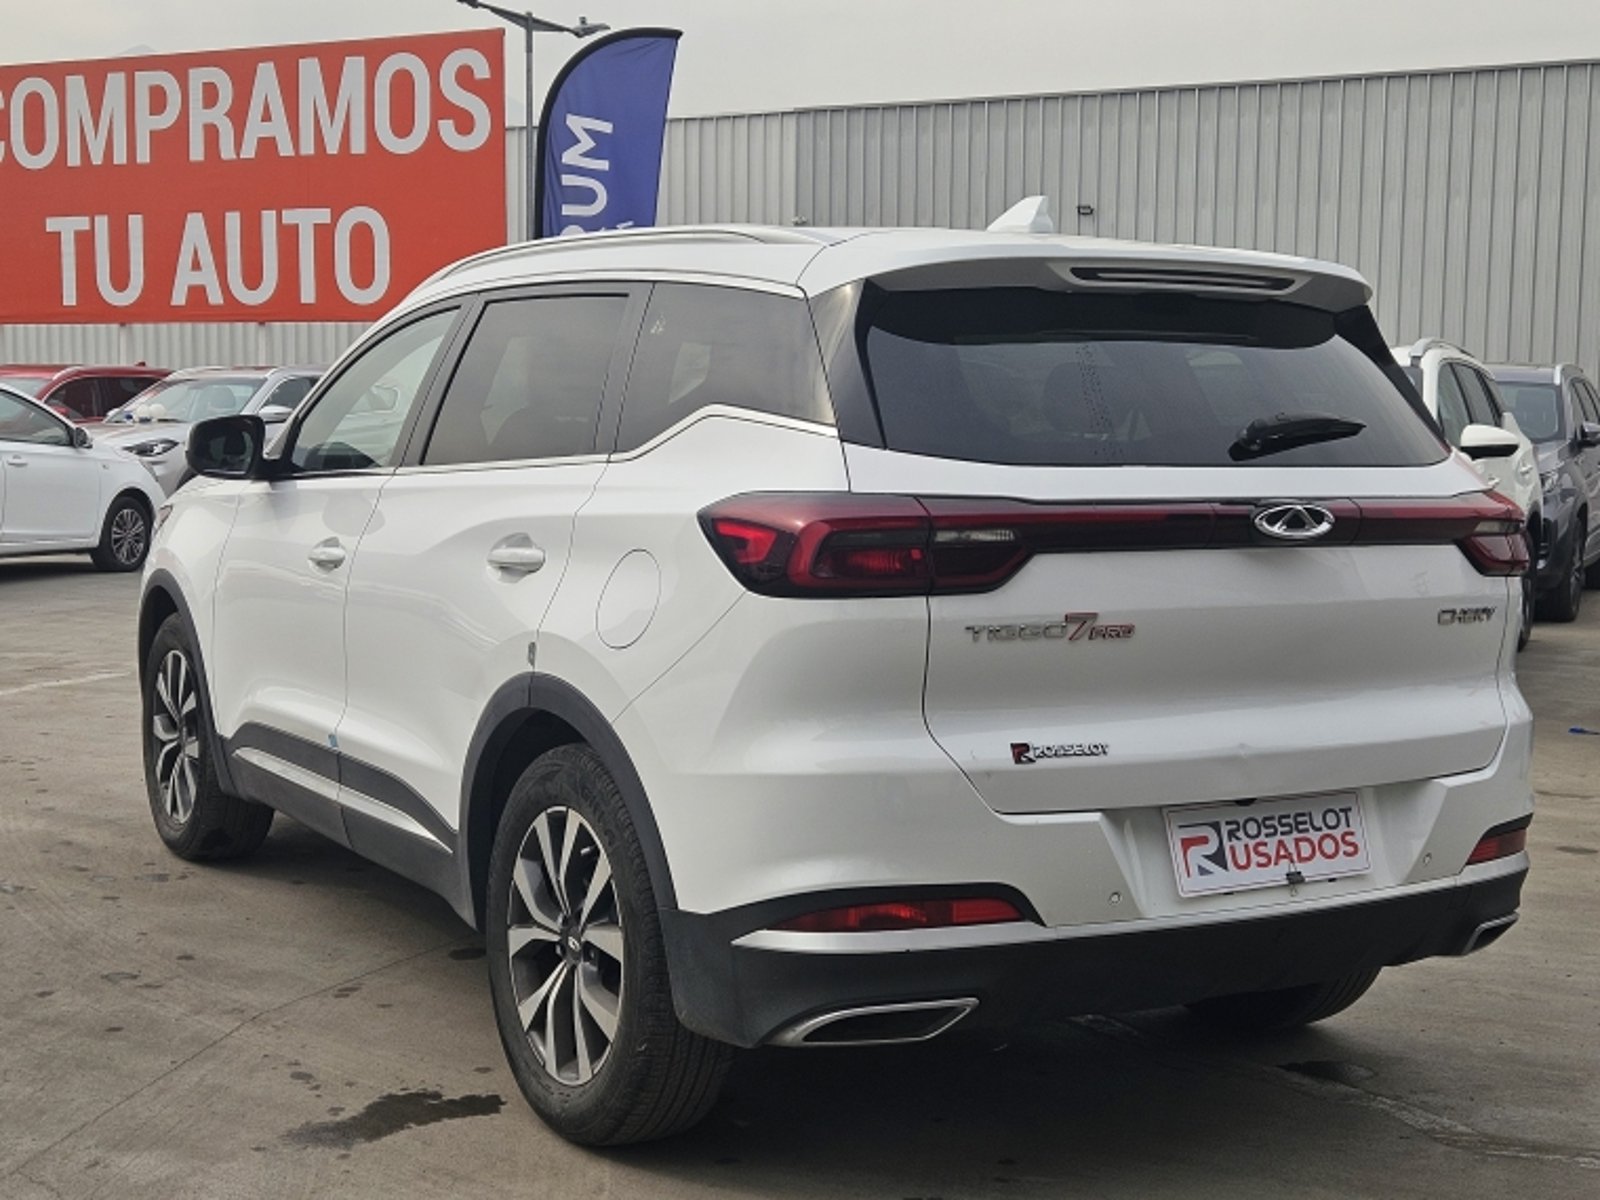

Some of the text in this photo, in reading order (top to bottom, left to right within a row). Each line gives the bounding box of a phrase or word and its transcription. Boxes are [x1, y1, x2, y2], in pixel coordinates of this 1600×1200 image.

[0, 47, 492, 170] OMPRAMOS
[45, 205, 391, 307] TU AUTO
[1437, 606, 1496, 624] CHERY
[1225, 807, 1353, 843] ROSSELOT
[1229, 831, 1360, 871] USADOS
